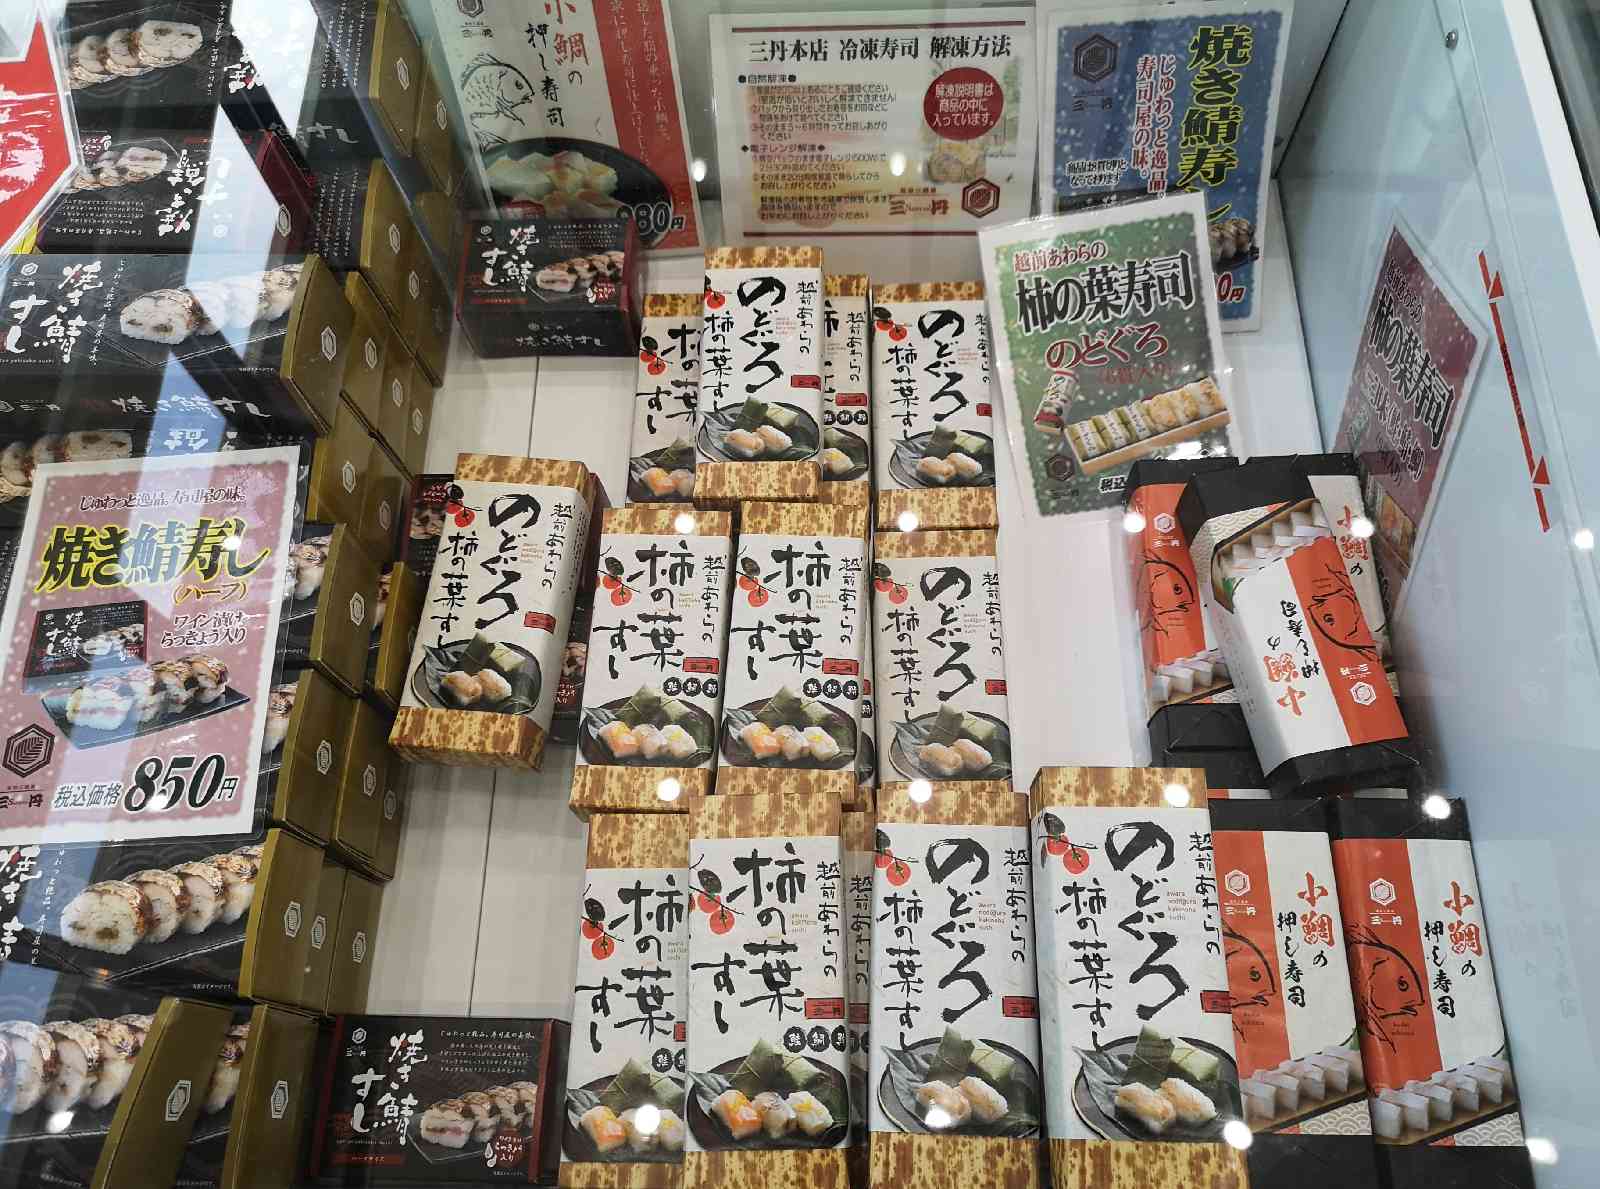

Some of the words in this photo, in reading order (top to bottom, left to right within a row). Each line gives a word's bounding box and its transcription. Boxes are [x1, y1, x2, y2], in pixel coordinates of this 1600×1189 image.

[525, 22, 564, 127] 押し寿司
[749, 39, 828, 62] 三丹本店
[840, 38, 919, 60] 冷凍寿司
[930, 34, 1012, 58] 解凍方法
[936, 83, 994, 98] 解凍説明書は
[933, 114, 994, 127] 入っています。
[939, 99, 988, 113] 商品の中に
[1132, 54, 1156, 179] 寿司屋の味。
[1147, 54, 1176, 199] じゅわっと逸品。
[481, 248, 508, 286] すし
[502, 225, 540, 292] 焼き鯖
[1014, 240, 1106, 273] 越前あわらの
[1015, 251, 1195, 335] 柿の葉寿司
[1215, 272, 1246, 303] 0円
[6, 294, 49, 353] すし
[40, 261, 103, 364] 焼き鯖
[738, 276, 787, 393] のどぐろ
[796, 280, 818, 355] 越前あわらの
[846, 311, 866, 382] 越前あわらの
[1046, 322, 1169, 369] のどぐろ
[704, 310, 734, 412] 柿の葉すし
[888, 342, 920, 440] 柿の葉すし
[918, 309, 968, 421] のどぐろ
[1370, 286, 1455, 448] 柿の葉寿司
[636, 385, 672, 435] すし
[36, 517, 272, 592] 焼き鯖寿し
[173, 583, 249, 605] (ハーフ)
[431, 531, 479, 649] 柿の葉すし
[474, 493, 541, 630] のどぐろ
[542, 502, 576, 591] 越前あわらの
[161, 628, 246, 648] らっきょう入り
[174, 612, 244, 629] ワイン漬け
[627, 540, 695, 671] 柿の葉
[701, 554, 727, 645] 越前あわらの
[763, 541, 831, 673] 柿の葉
[838, 555, 863, 644] 越前あわらの
[920, 566, 977, 701] のどぐろ
[1280, 600, 1321, 679] 押し寿司
[593, 619, 639, 679] すし
[730, 620, 776, 680] すし
[882, 606, 922, 722] 柿の葉すし
[1263, 636, 1306, 716] 小鯛の
[54, 783, 122, 809] 税込価格
[124, 753, 239, 813] 850円
[726, 842, 807, 1021] 柿の葉
[816, 860, 841, 979] 越前あわらの
[850, 875, 872, 985] 越前あわらの
[925, 837, 992, 1023] のどぐろ
[1004, 848, 1029, 963] 越前あわらの
[1104, 820, 1189, 1021] のどぐろ
[1188, 831, 1222, 955] 越前あわらの
[1297, 872, 1335, 968] 小鯛の
[1443, 881, 1483, 977] 小鯛の
[608, 875, 684, 1042] 柿の葉
[690, 952, 747, 1034] すし
[877, 889, 924, 1051] 柿の葉すし
[1055, 877, 1112, 1052] 柿の葉すし
[1276, 911, 1305, 1008] 押し寿司
[1425, 920, 1456, 1018] 押し寿司
[575, 976, 623, 1053] すし
[352, 1068, 386, 1133] すし
[377, 1029, 428, 1146] 焼き鯖
